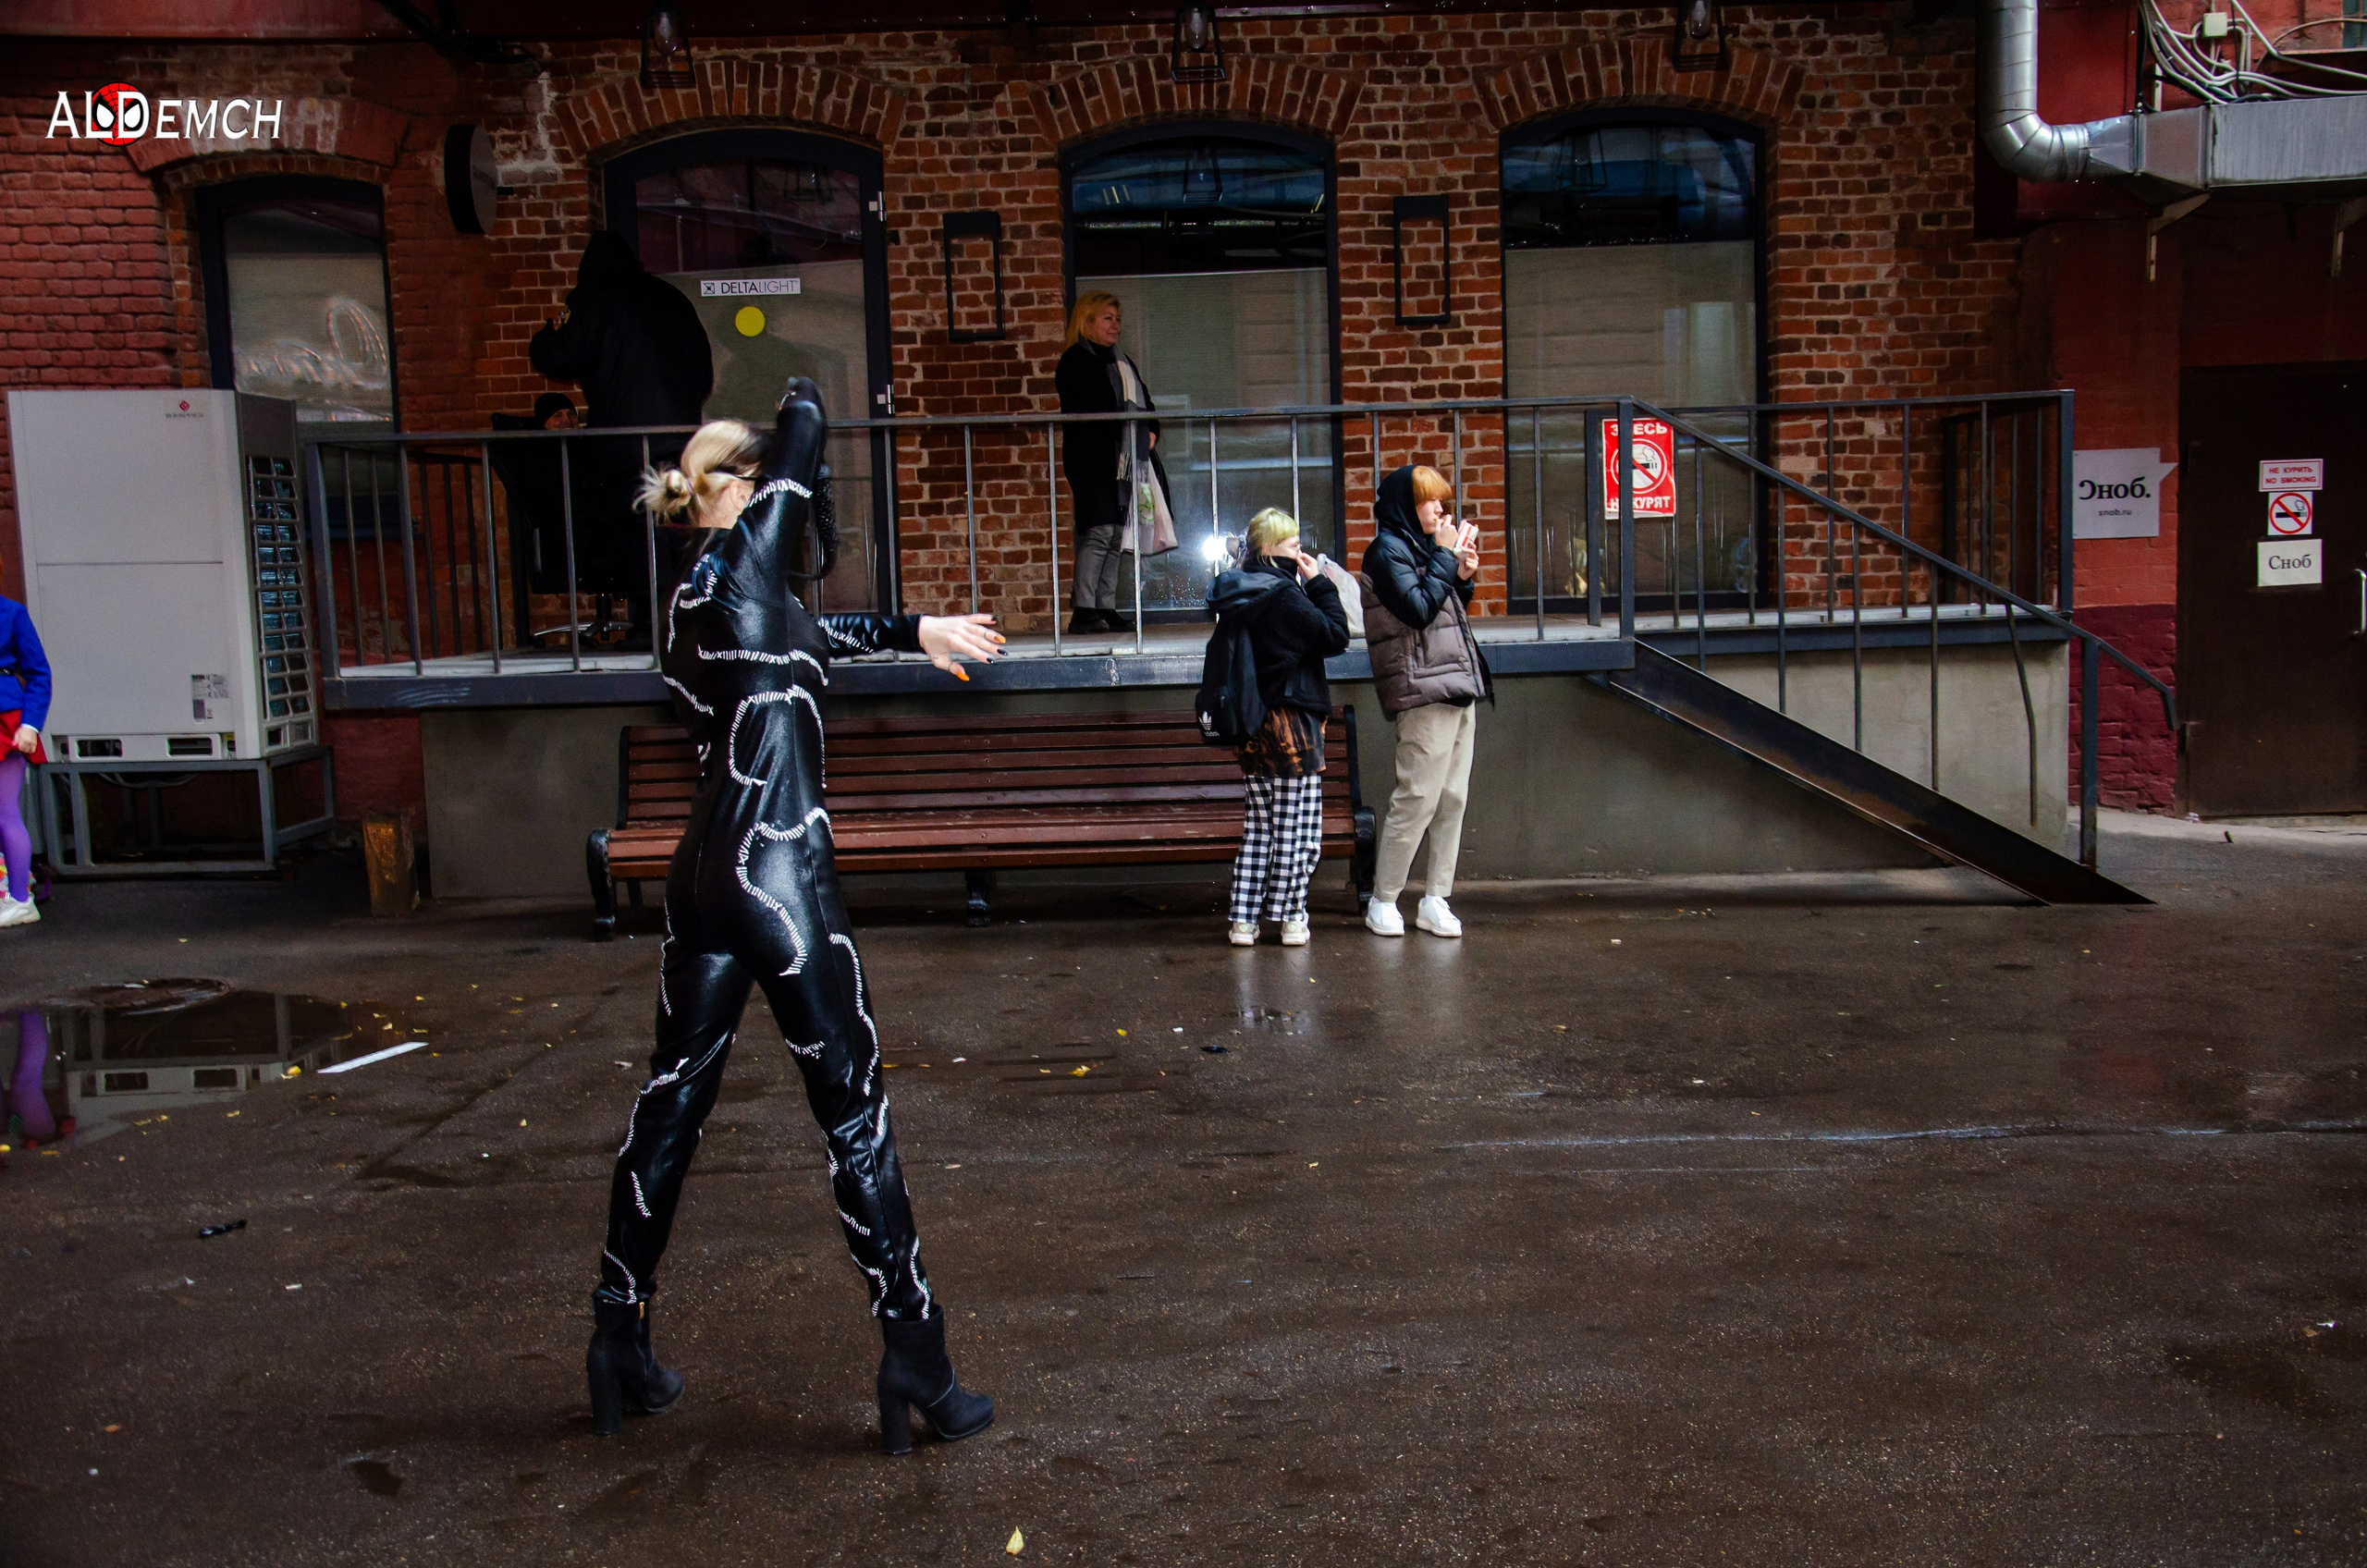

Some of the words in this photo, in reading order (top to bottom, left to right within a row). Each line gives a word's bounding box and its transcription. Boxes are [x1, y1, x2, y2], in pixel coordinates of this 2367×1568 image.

[721, 280, 795, 294] DELTALIGHT
[1610, 422, 1668, 436] ЗЕСЬ
[2098, 508, 2133, 517] snob.ru
[2268, 554, 2312, 570] Сноб
